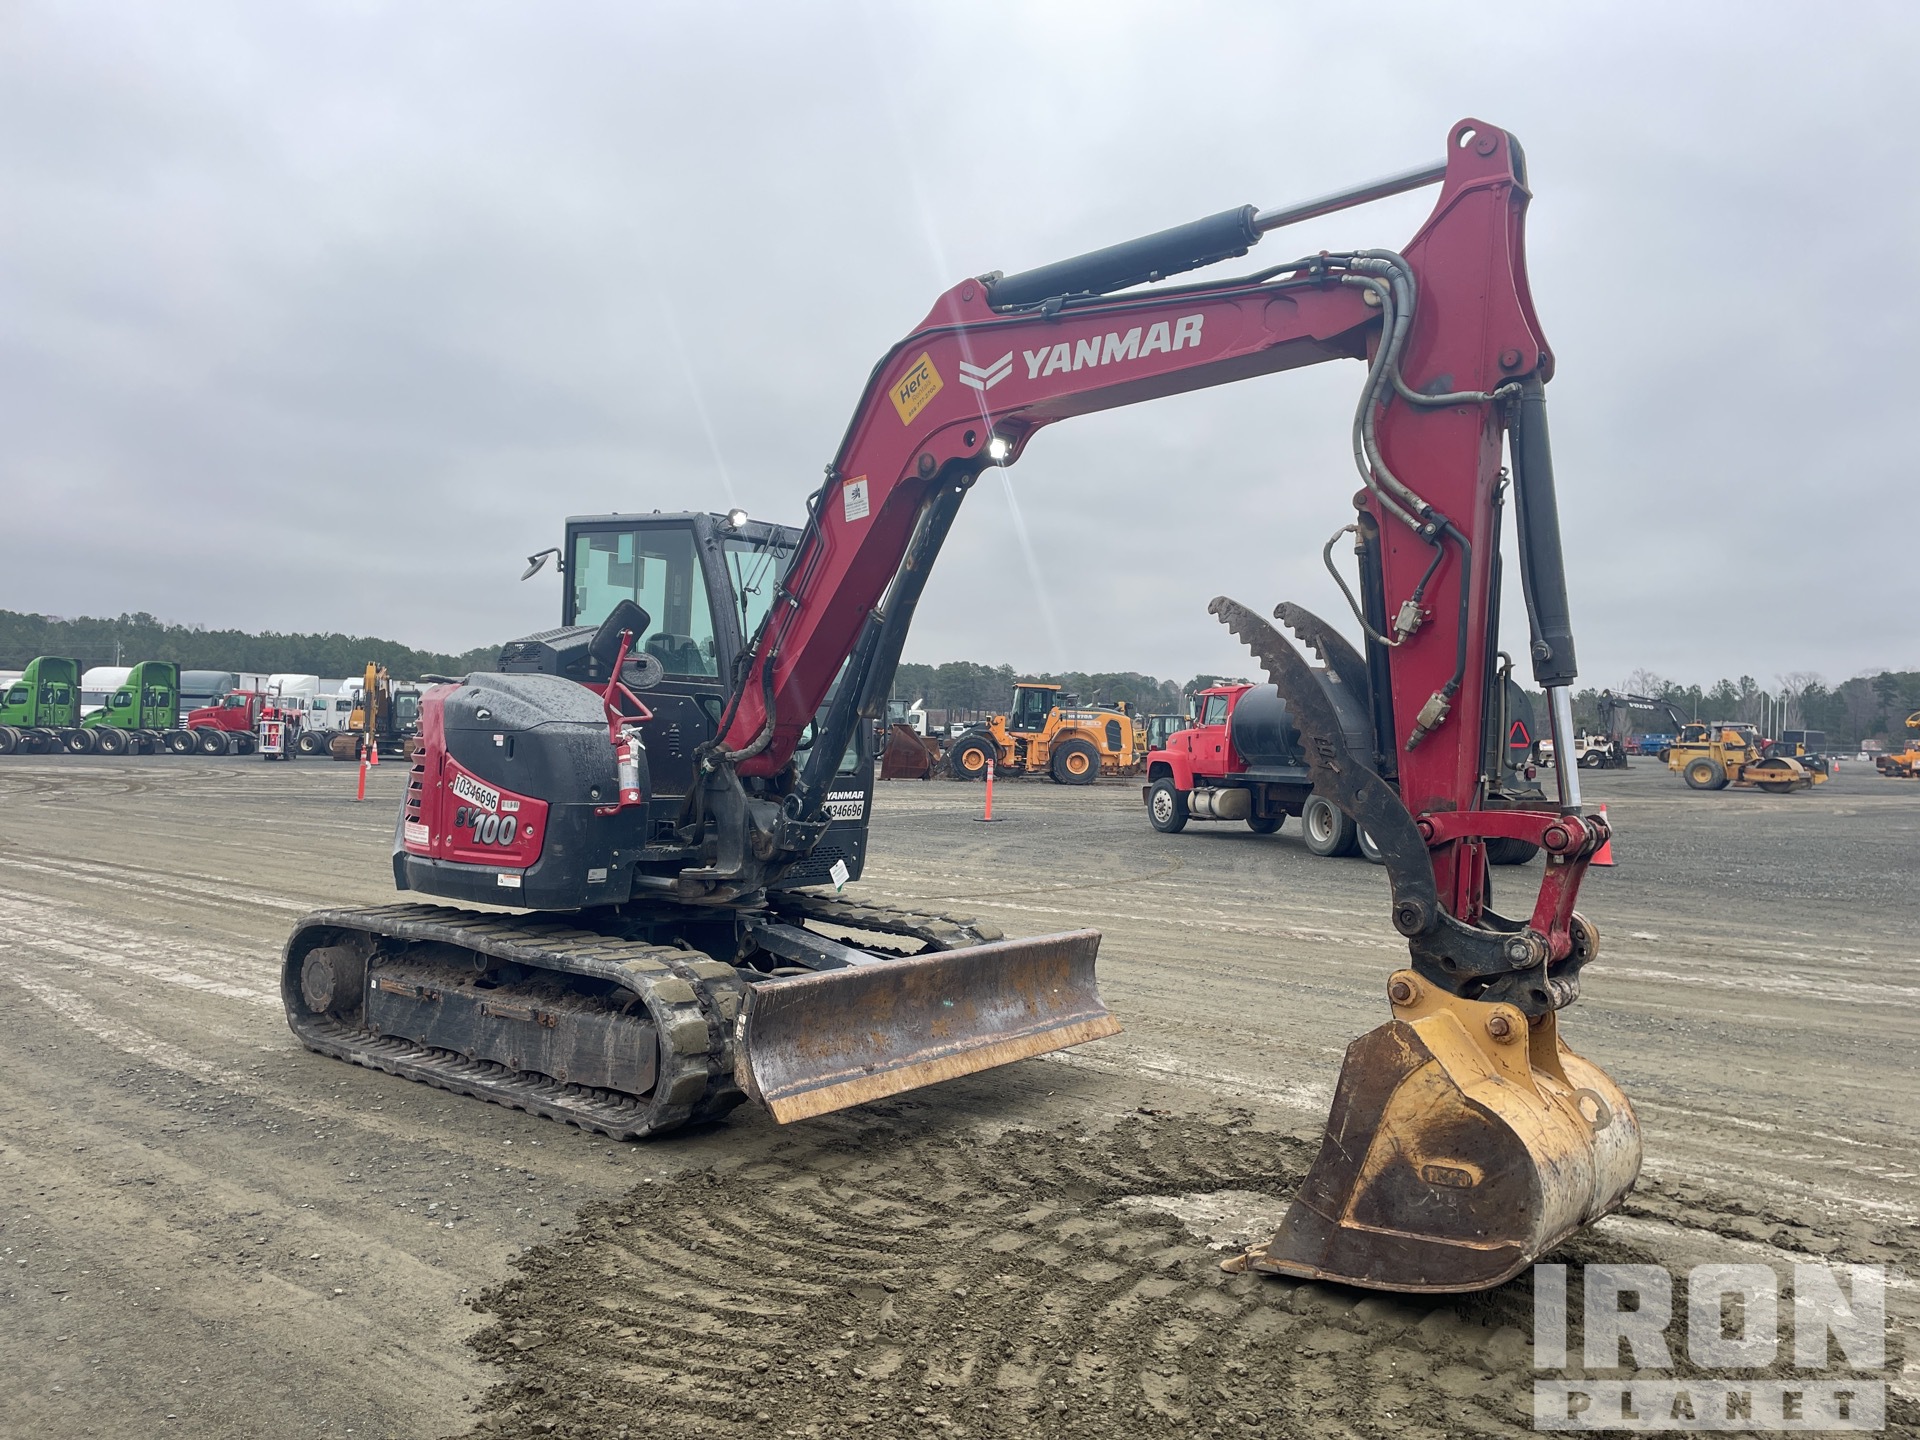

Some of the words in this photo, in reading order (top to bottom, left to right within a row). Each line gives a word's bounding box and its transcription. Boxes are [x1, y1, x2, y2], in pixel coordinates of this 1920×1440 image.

[1023, 314, 1204, 379] YANMAR
[900, 367, 929, 405] Herc
[912, 379, 931, 402] Rentals
[1628, 702, 1655, 710] VOLVO
[455, 776, 498, 810] 10346696
[827, 791, 864, 800] YANMAR
